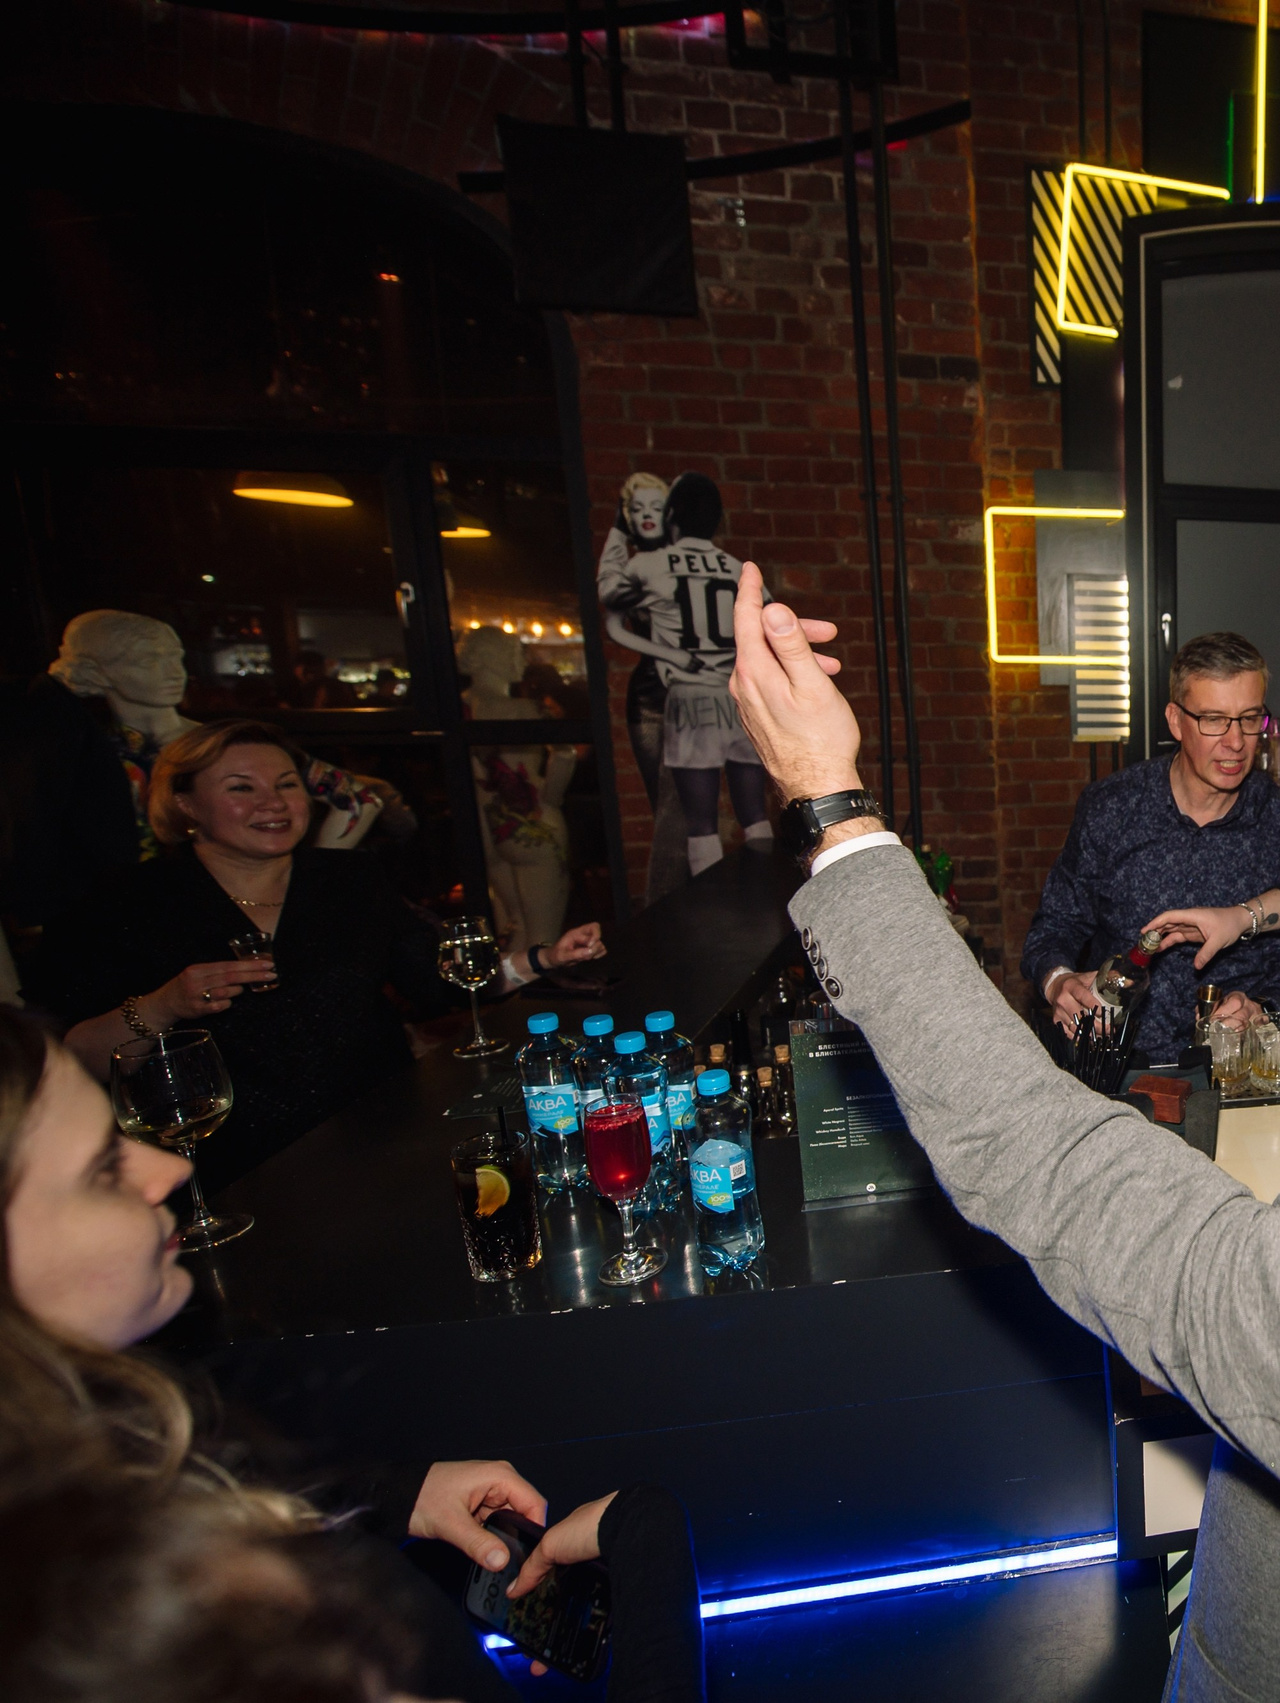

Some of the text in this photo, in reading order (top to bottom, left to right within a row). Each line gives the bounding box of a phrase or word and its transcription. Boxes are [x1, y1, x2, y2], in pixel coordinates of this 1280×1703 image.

[668, 553, 732, 574] PELE
[674, 577, 739, 650] 10
[528, 1096, 567, 1112] АКВА
